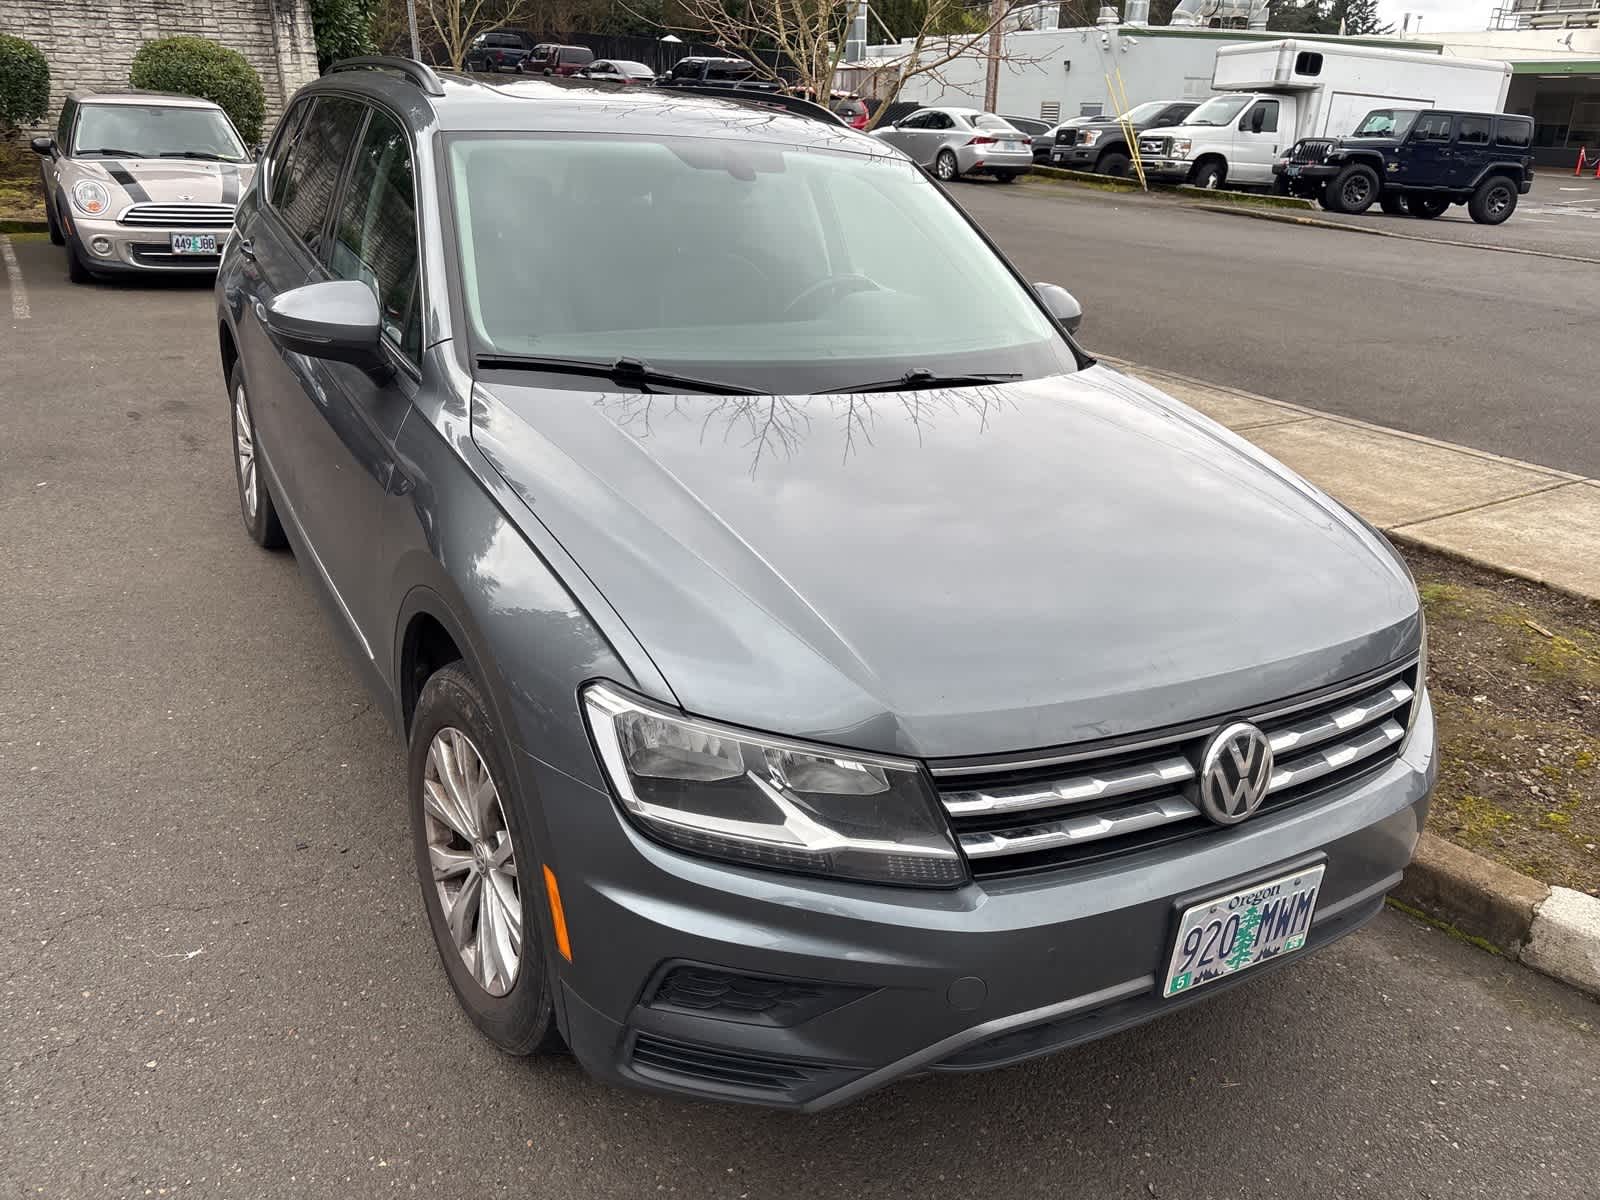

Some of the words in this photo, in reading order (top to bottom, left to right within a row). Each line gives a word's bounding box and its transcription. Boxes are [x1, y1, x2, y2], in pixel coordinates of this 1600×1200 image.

[174, 237, 192, 249] 449
[1203, 723, 1273, 823] VW
[1228, 884, 1281, 910] Oregon
[1179, 914, 1241, 972] 920
[1254, 887, 1315, 948] MWM
[1176, 975, 1185, 989] 5
